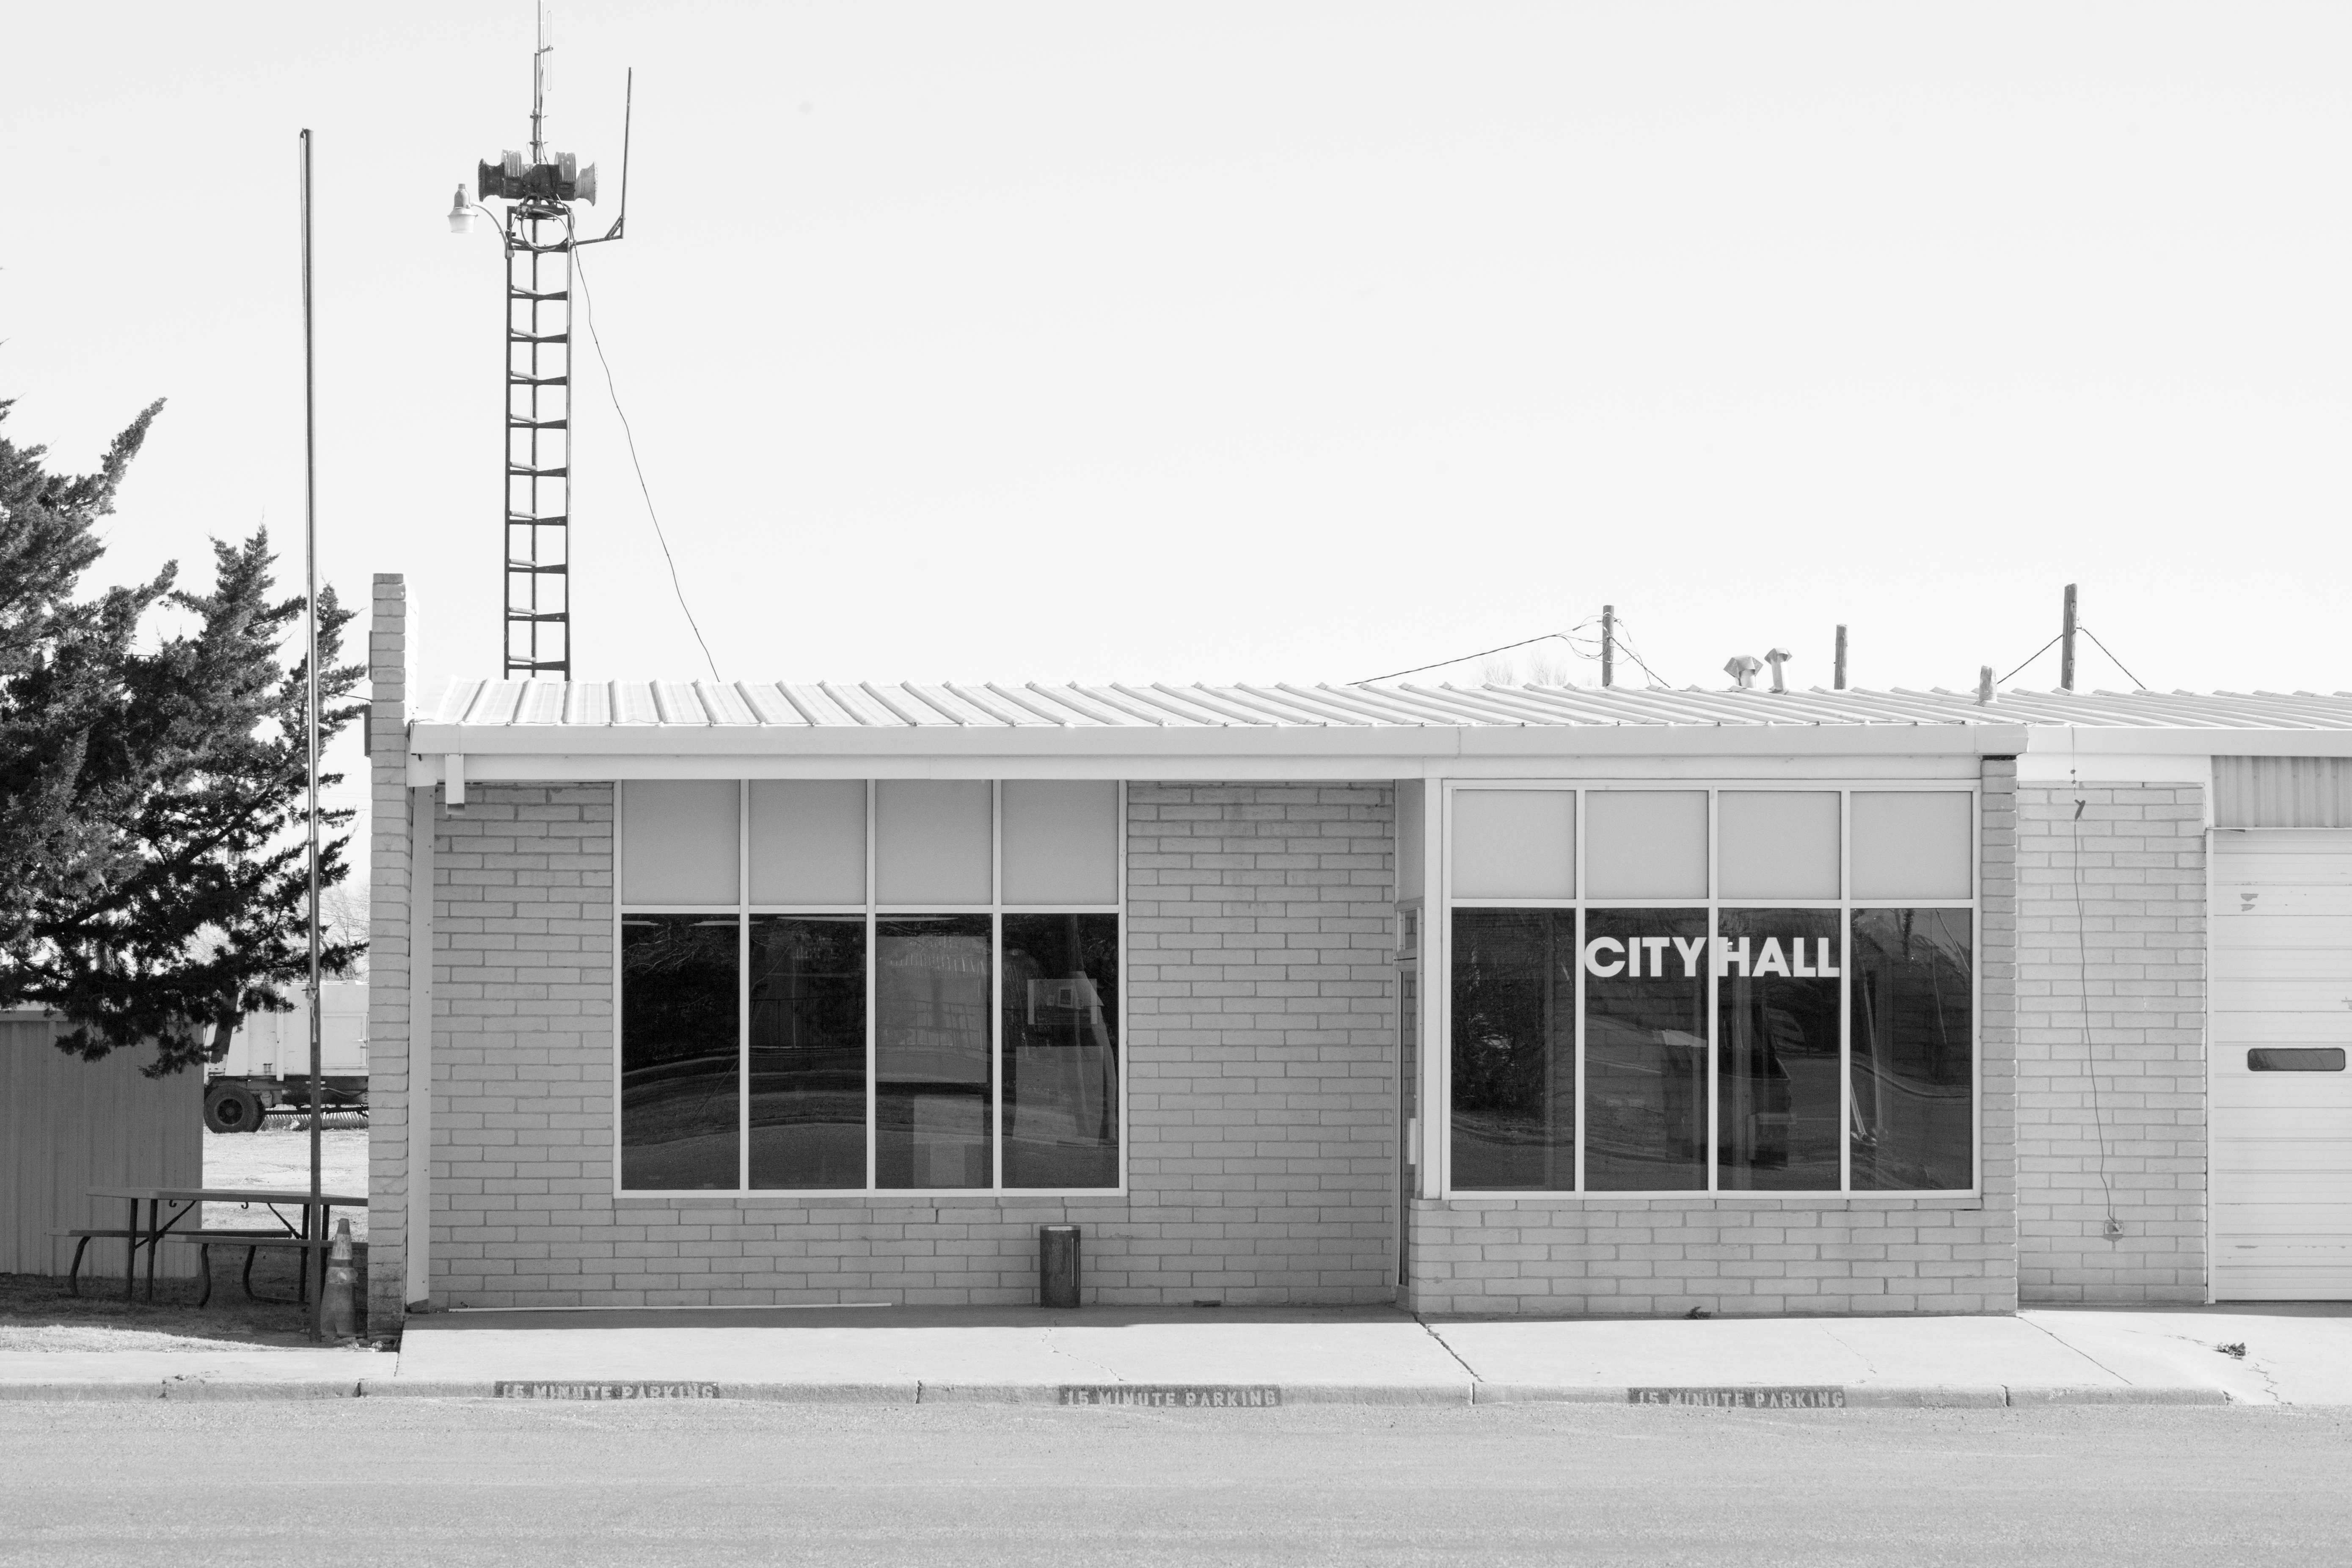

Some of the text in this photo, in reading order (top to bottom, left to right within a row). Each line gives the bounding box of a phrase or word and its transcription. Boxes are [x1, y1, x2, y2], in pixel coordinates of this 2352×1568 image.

[1584, 937, 1840, 977] CITY HALL
[534, 1385, 613, 1398] MINUTE
[621, 1385, 714, 1399] PARKING
[1065, 1390, 1275, 1407] 15 MINUTE PARKING
[1639, 1392, 1843, 1408] 15 MINUTE PARKING
